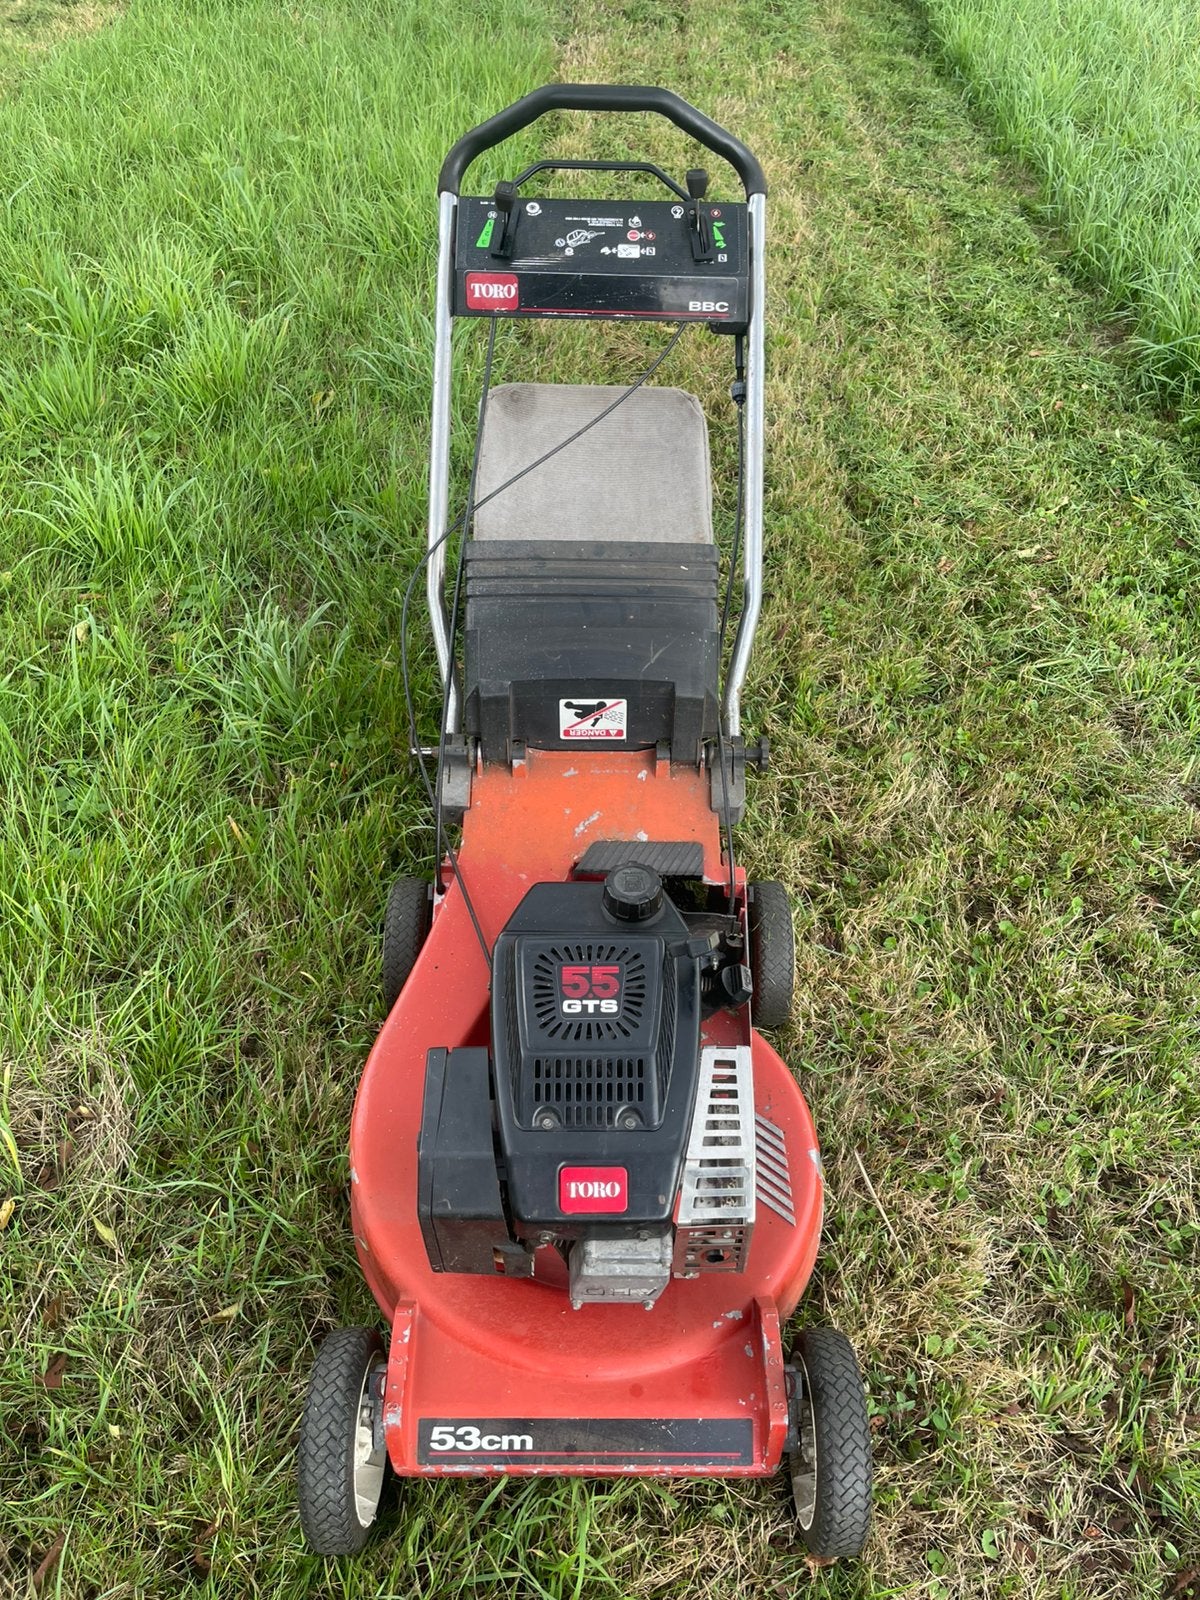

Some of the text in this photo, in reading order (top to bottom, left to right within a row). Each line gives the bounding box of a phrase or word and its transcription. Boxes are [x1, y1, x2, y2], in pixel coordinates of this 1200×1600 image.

[470, 283, 516, 299] TORO
[688, 301, 729, 312] BBC
[561, 966, 620, 998] 5.5
[562, 999, 619, 1014] GTS
[566, 1181, 621, 1199] TORO
[585, 1287, 657, 1296] OHV
[386, 1402, 399, 1411] 3
[774, 1402, 786, 1411] 3
[429, 1426, 534, 1451] 53cm
